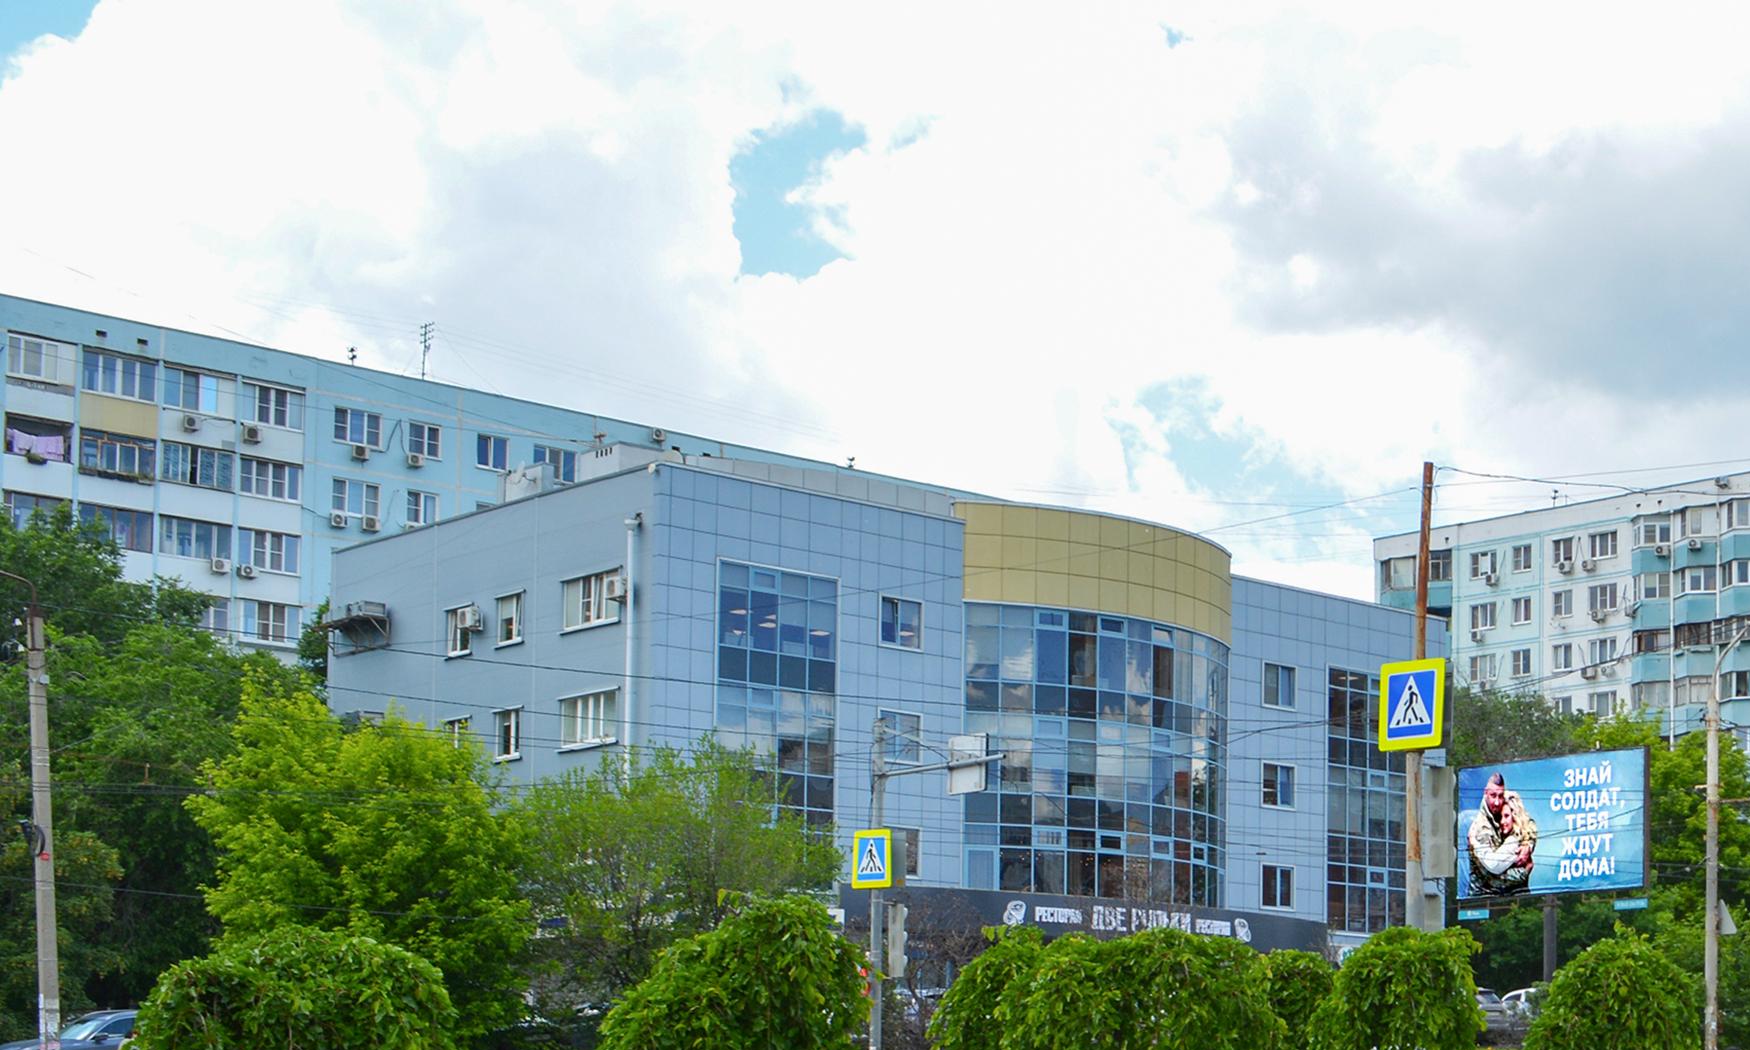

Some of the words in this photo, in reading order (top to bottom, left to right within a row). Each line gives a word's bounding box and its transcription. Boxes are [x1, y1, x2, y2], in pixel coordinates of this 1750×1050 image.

[1564, 760, 1612, 787] ЗНАЙ
[1550, 787, 1625, 812] СОЛДАТ,
[1564, 811, 1609, 832] ТЕБЯ
[1561, 833, 1614, 857] ЖДУТ
[1558, 856, 1615, 881] ДОМА!
